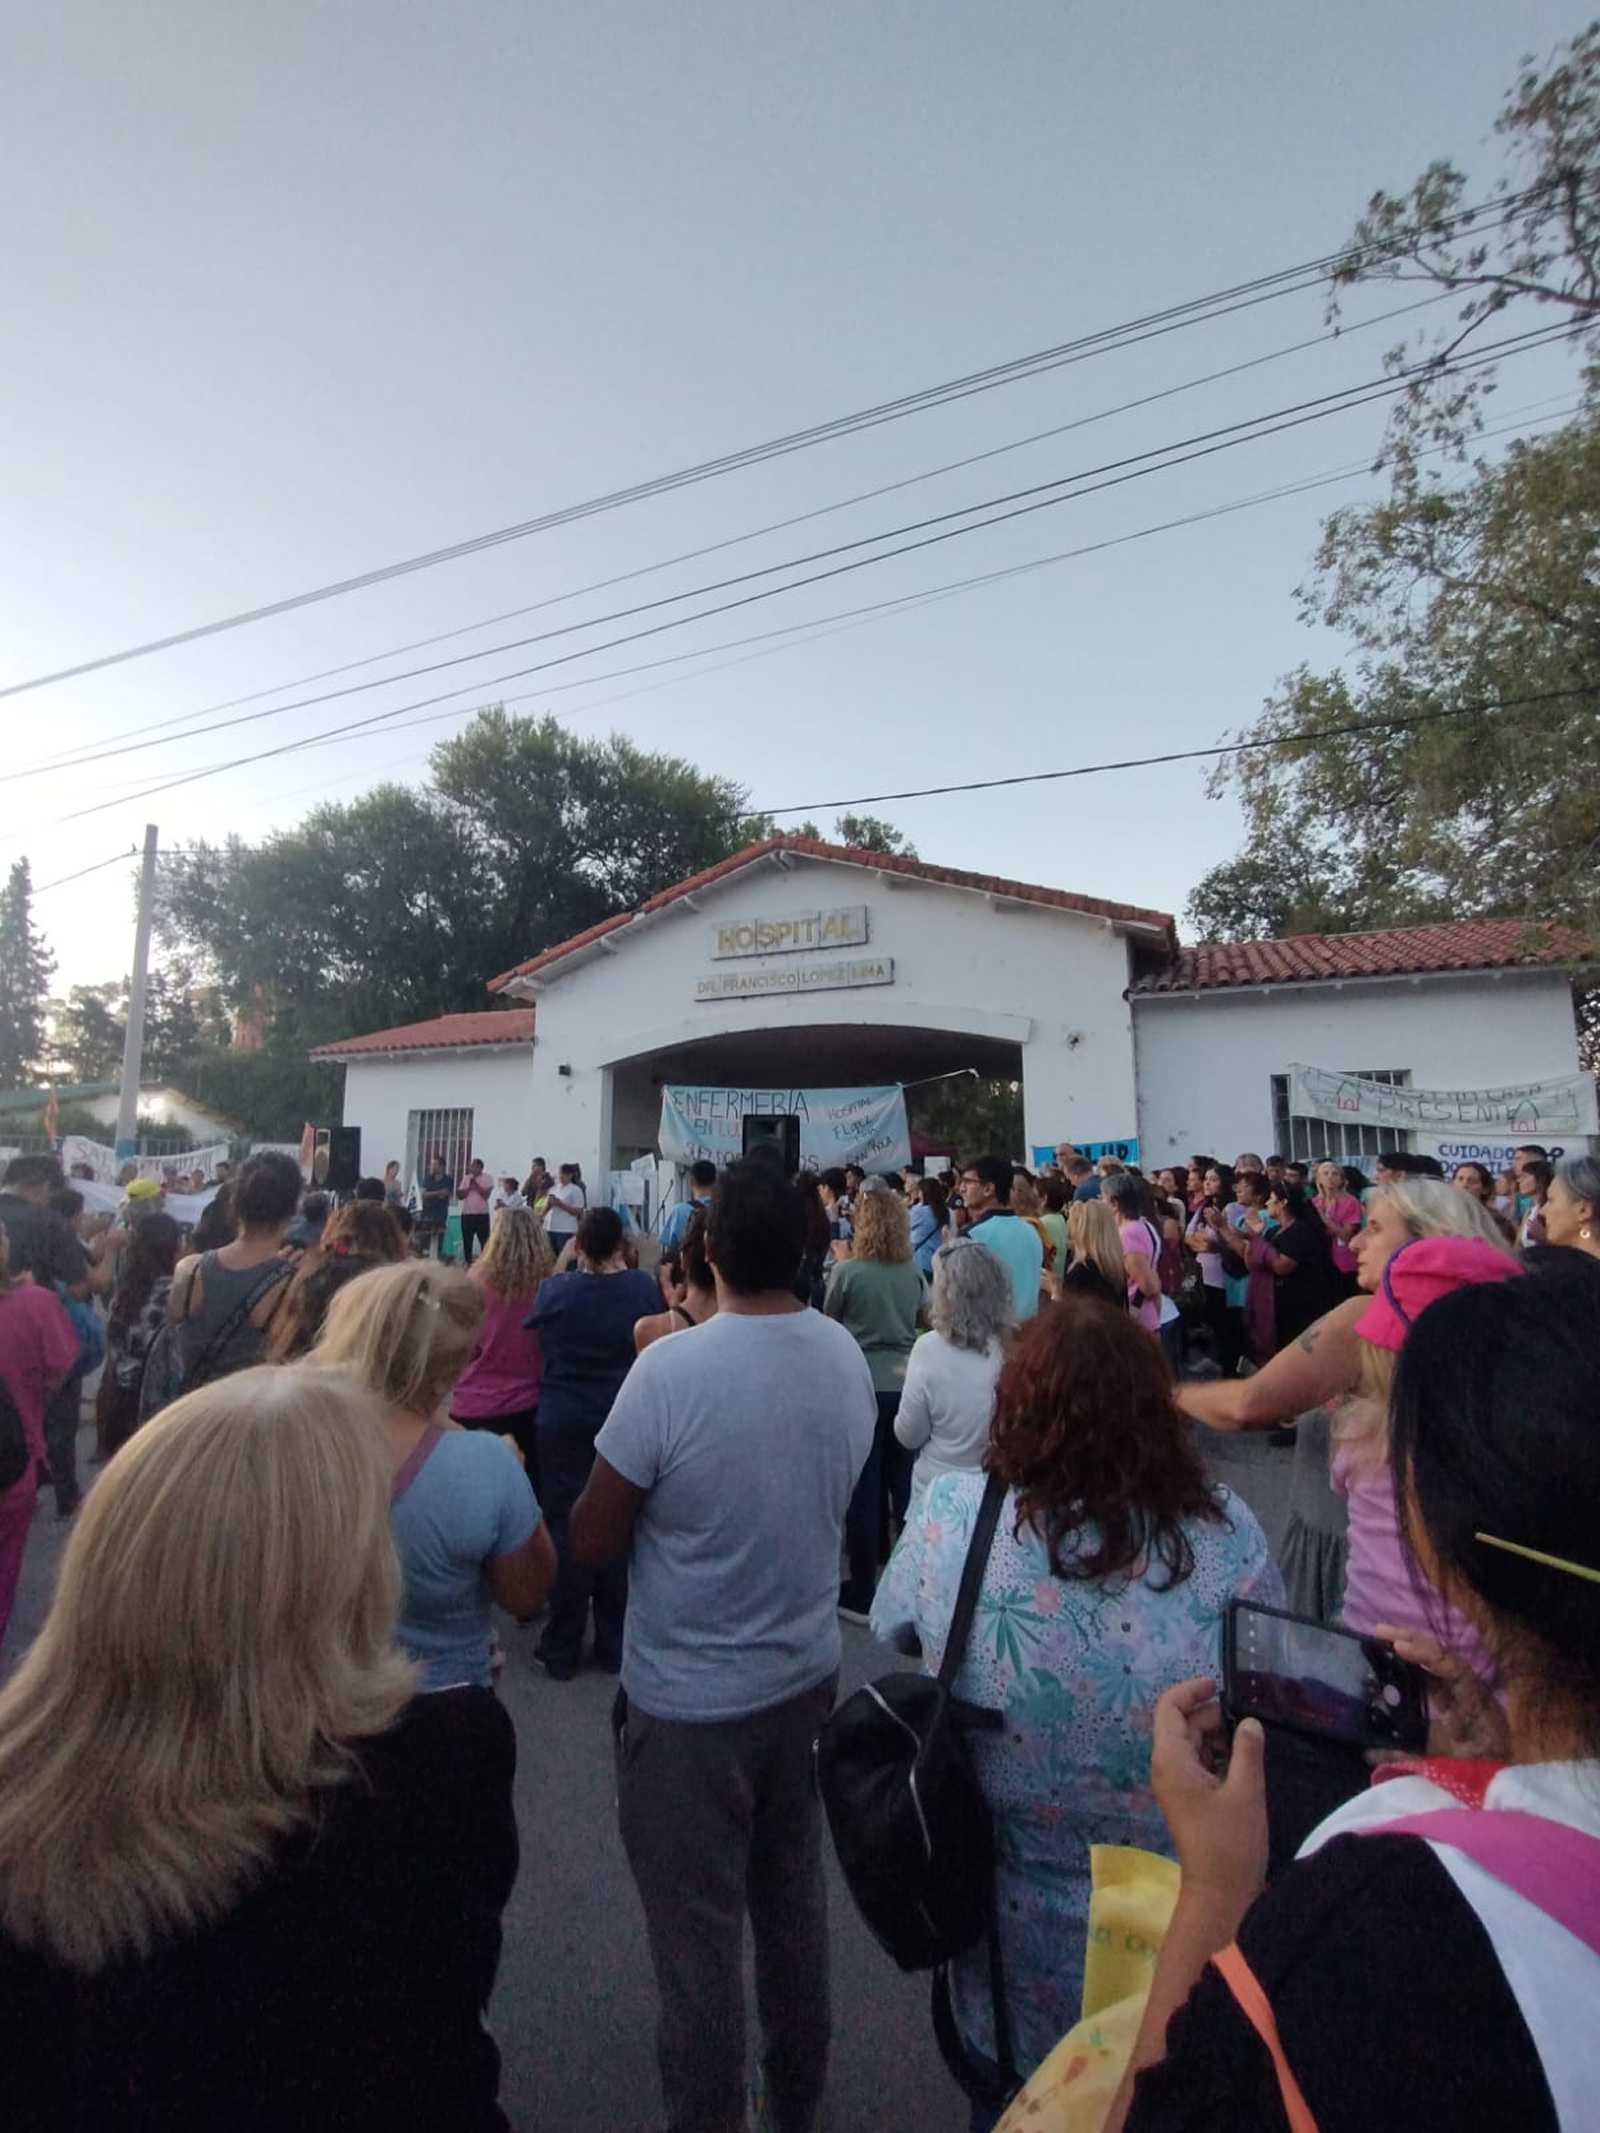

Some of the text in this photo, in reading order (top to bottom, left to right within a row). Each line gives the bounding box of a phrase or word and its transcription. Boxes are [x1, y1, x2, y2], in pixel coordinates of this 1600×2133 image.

[718, 914, 861, 952] HOSPITAL
[723, 973, 796, 992] FRANCISCO
[853, 963, 885, 980] LIMA
